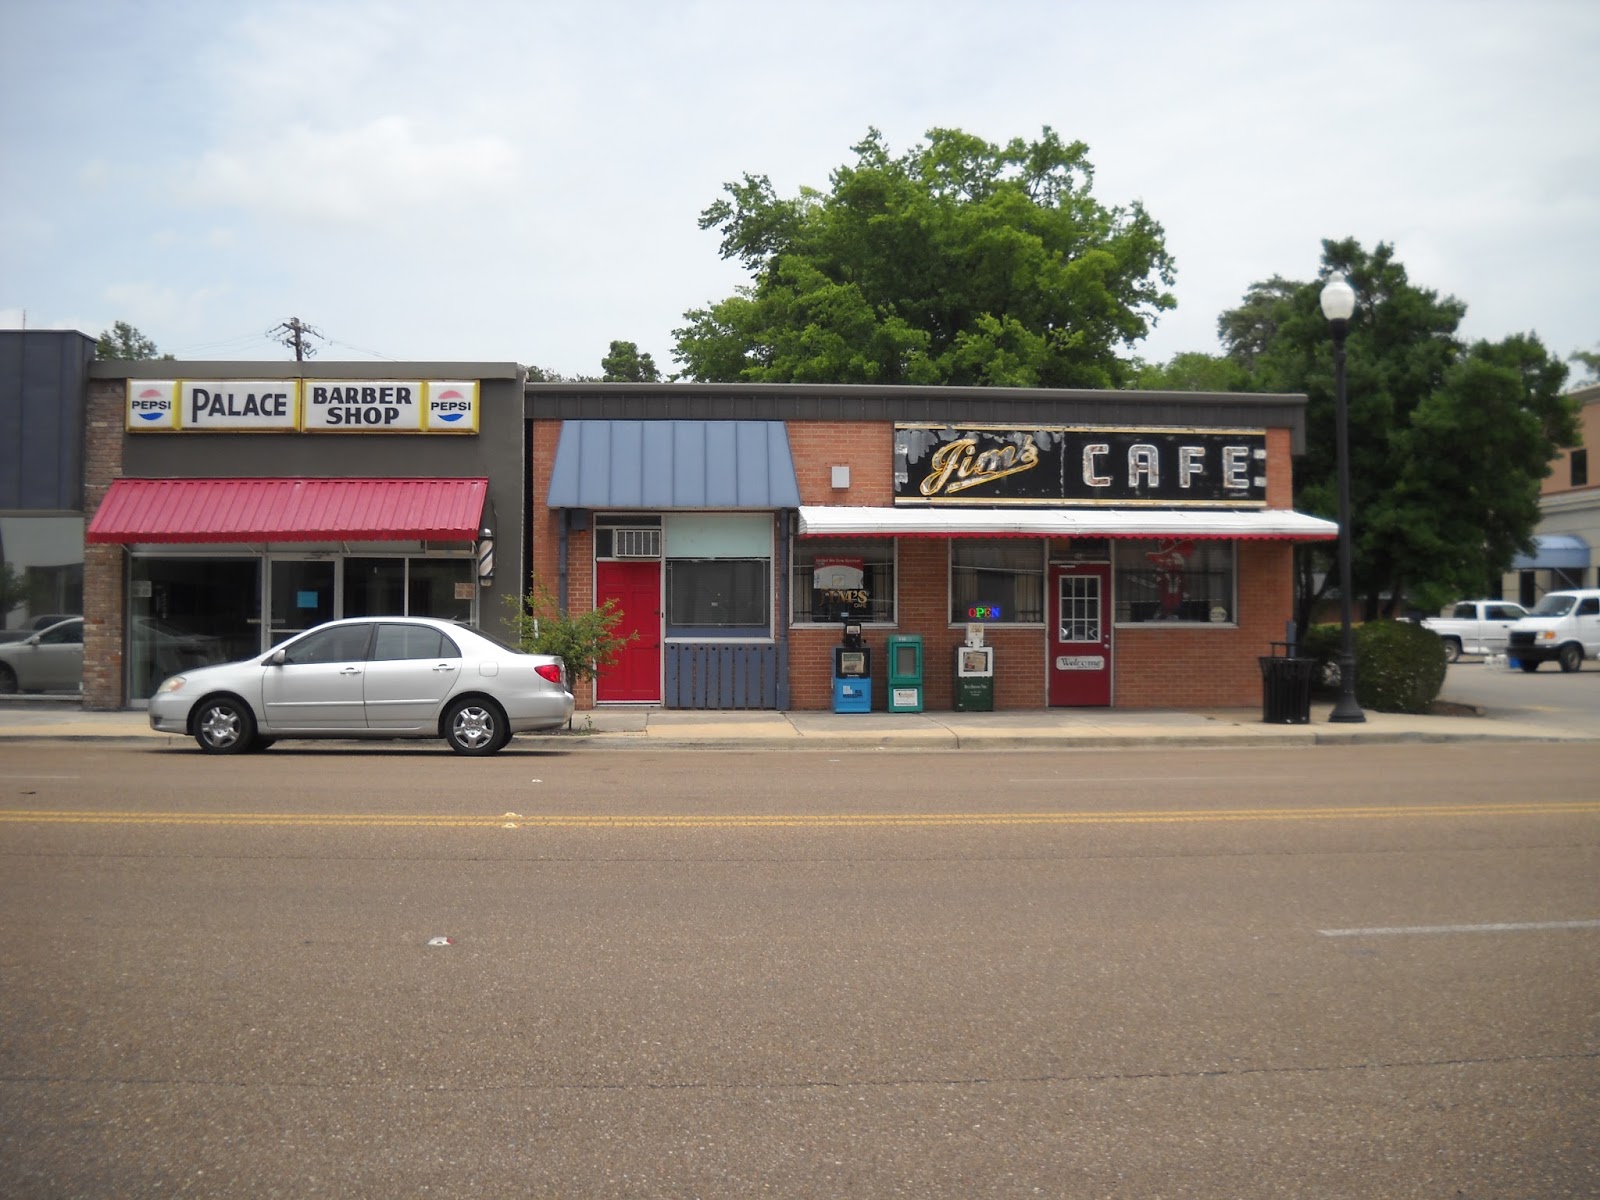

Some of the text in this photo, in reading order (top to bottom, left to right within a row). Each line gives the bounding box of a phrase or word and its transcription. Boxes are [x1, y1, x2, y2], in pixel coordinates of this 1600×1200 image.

[313, 387, 412, 405] BARBER
[131, 400, 171, 410] PEPSI
[192, 388, 287, 422] PALACE
[431, 401, 471, 411] PEPSI
[326, 406, 400, 425] SHOP
[1082, 443, 1250, 490] CAFE
[968, 607, 1000, 618] OPEN
[1061, 657, 1102, 668] Welcome
